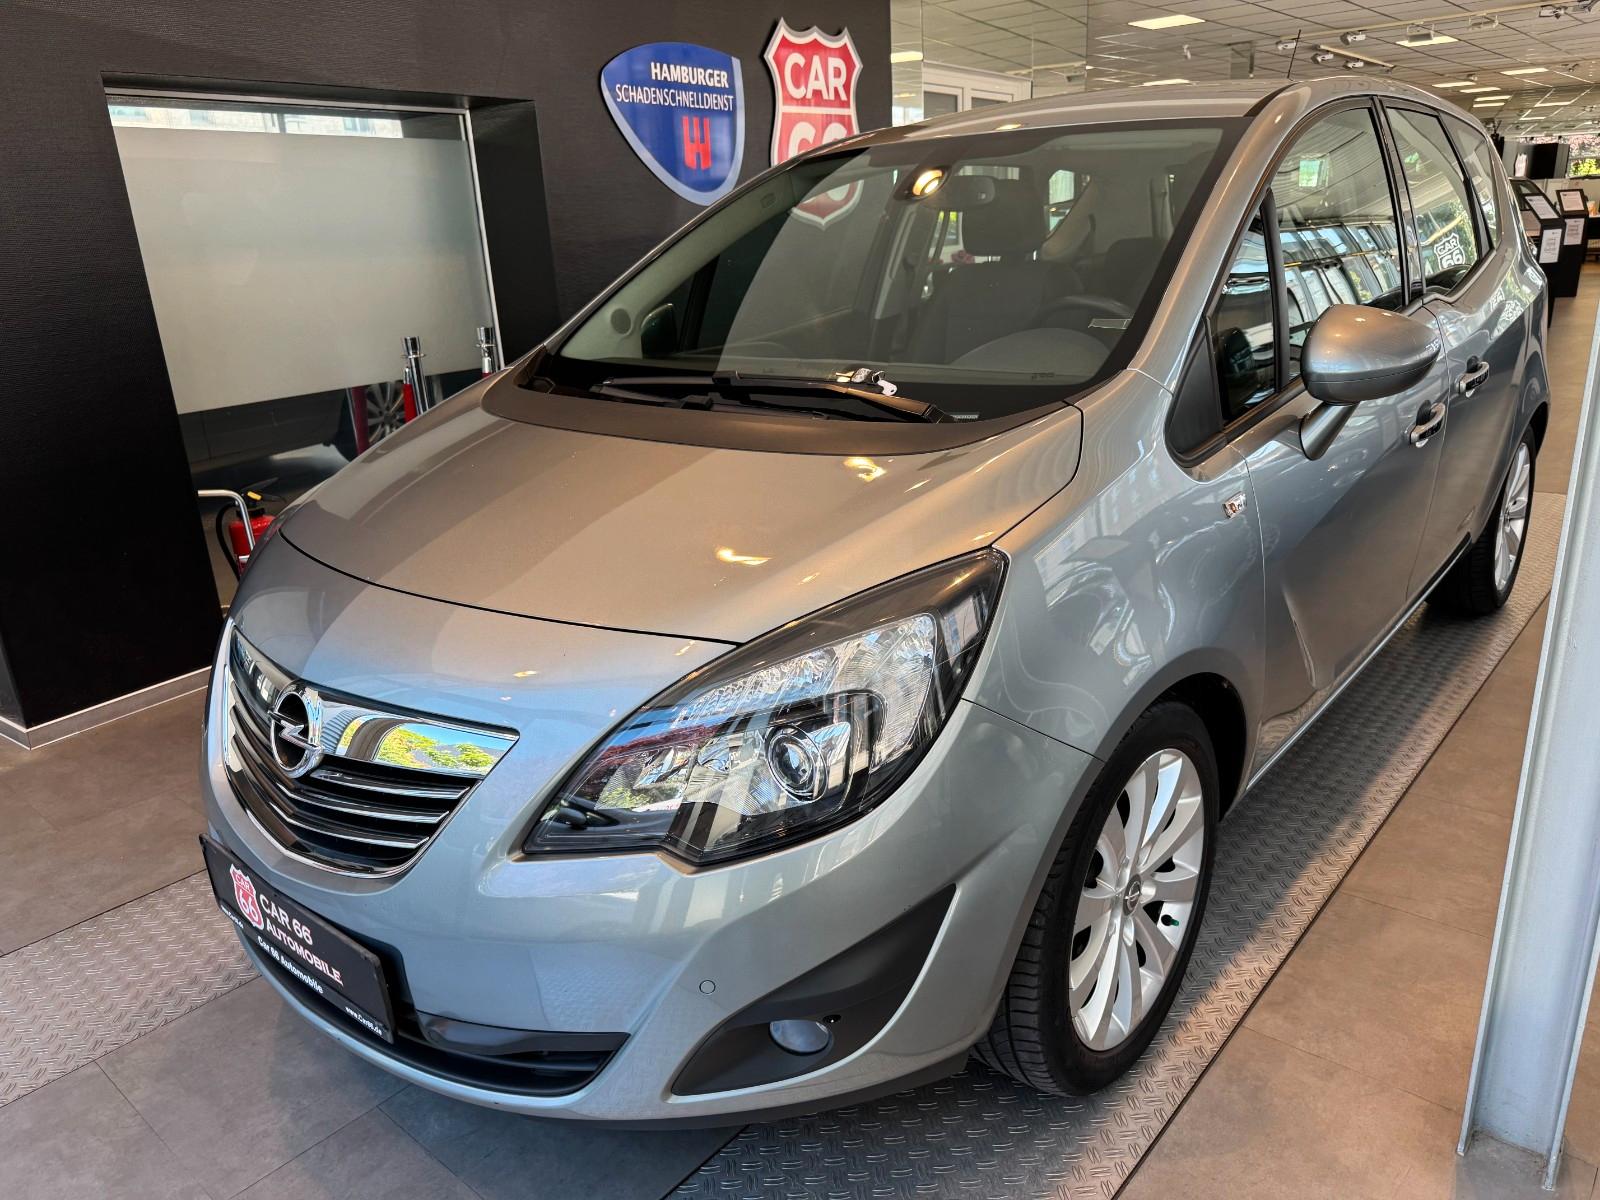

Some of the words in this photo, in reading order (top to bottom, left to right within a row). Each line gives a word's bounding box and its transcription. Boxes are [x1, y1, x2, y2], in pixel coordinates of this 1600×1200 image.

[650, 62, 729, 88] HAMBURGER
[784, 52, 848, 102] CAR
[615, 84, 734, 111] SCHADENSCHNELLDIENST
[1436, 238, 1458, 255] CAR
[240, 888, 259, 922] 66
[259, 894, 293, 931] CAR
[292, 918, 313, 946] 66
[266, 918, 344, 987] AUTOMOBILE
[280, 955, 324, 994] Automobile
